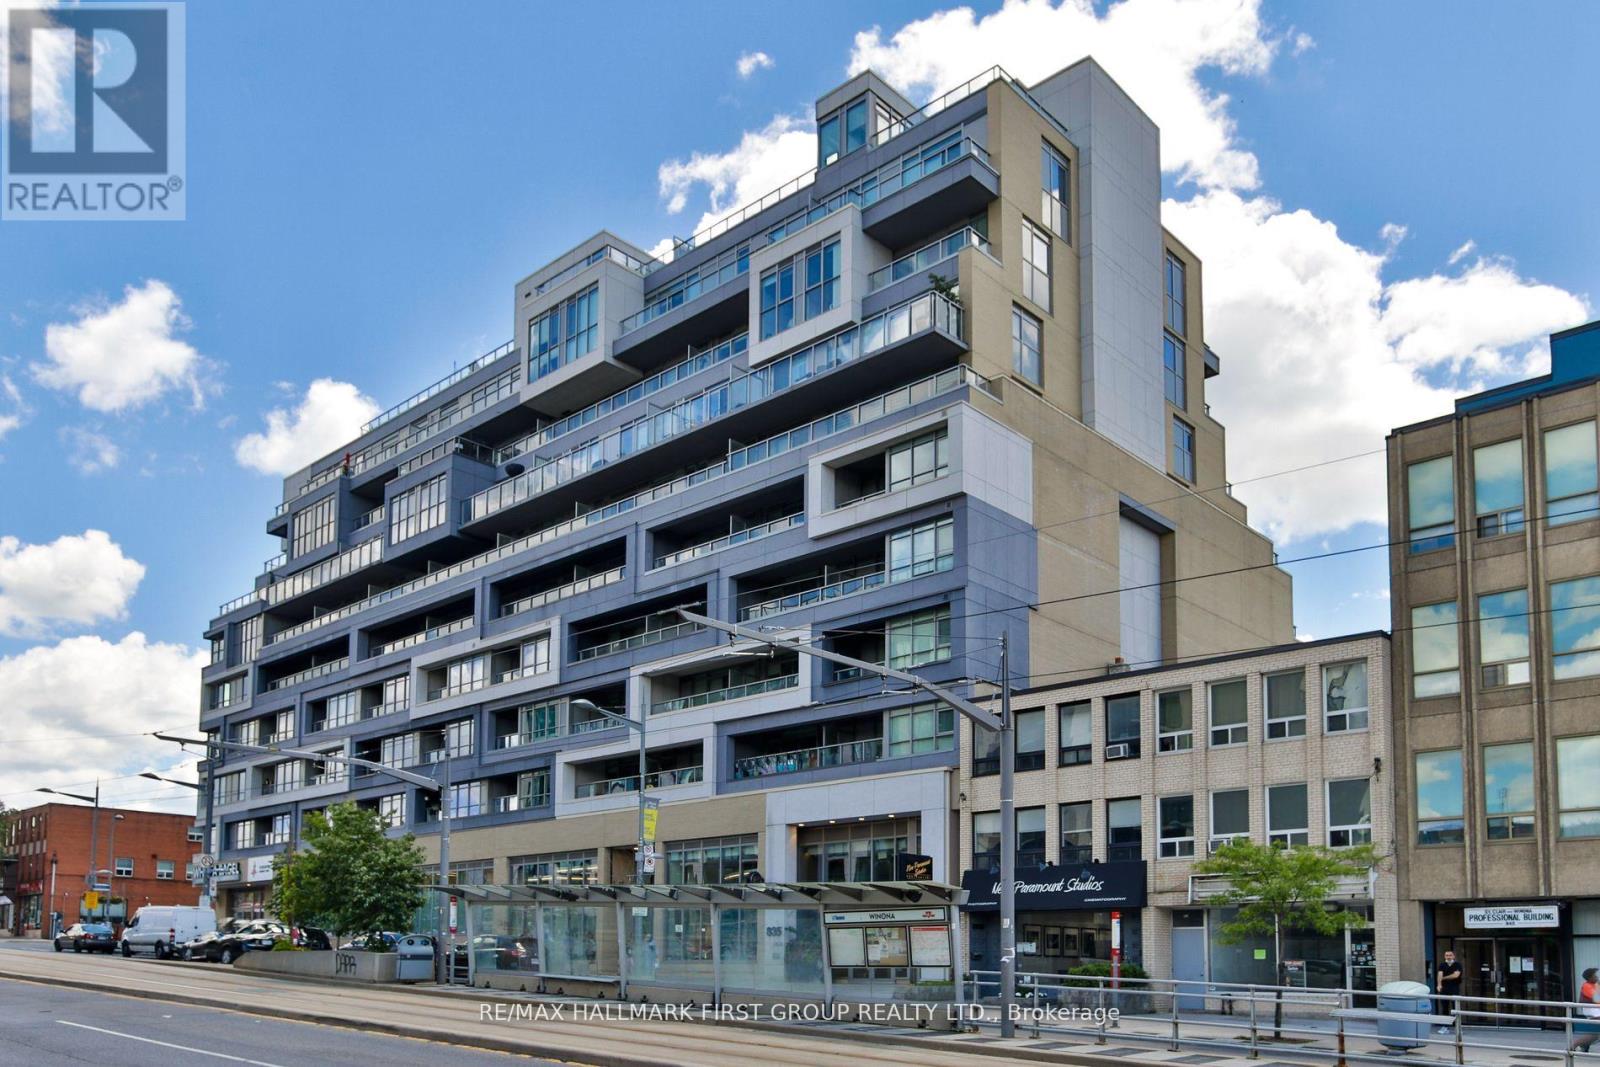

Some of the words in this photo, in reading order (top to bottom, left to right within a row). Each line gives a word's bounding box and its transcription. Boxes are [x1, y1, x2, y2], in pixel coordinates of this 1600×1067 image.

[1014, 878, 1064, 894] Paramount
[1064, 875, 1104, 893] Studios
[1469, 913, 1521, 922] PROFESSIONAL
[1523, 912, 1554, 921] BUILDING
